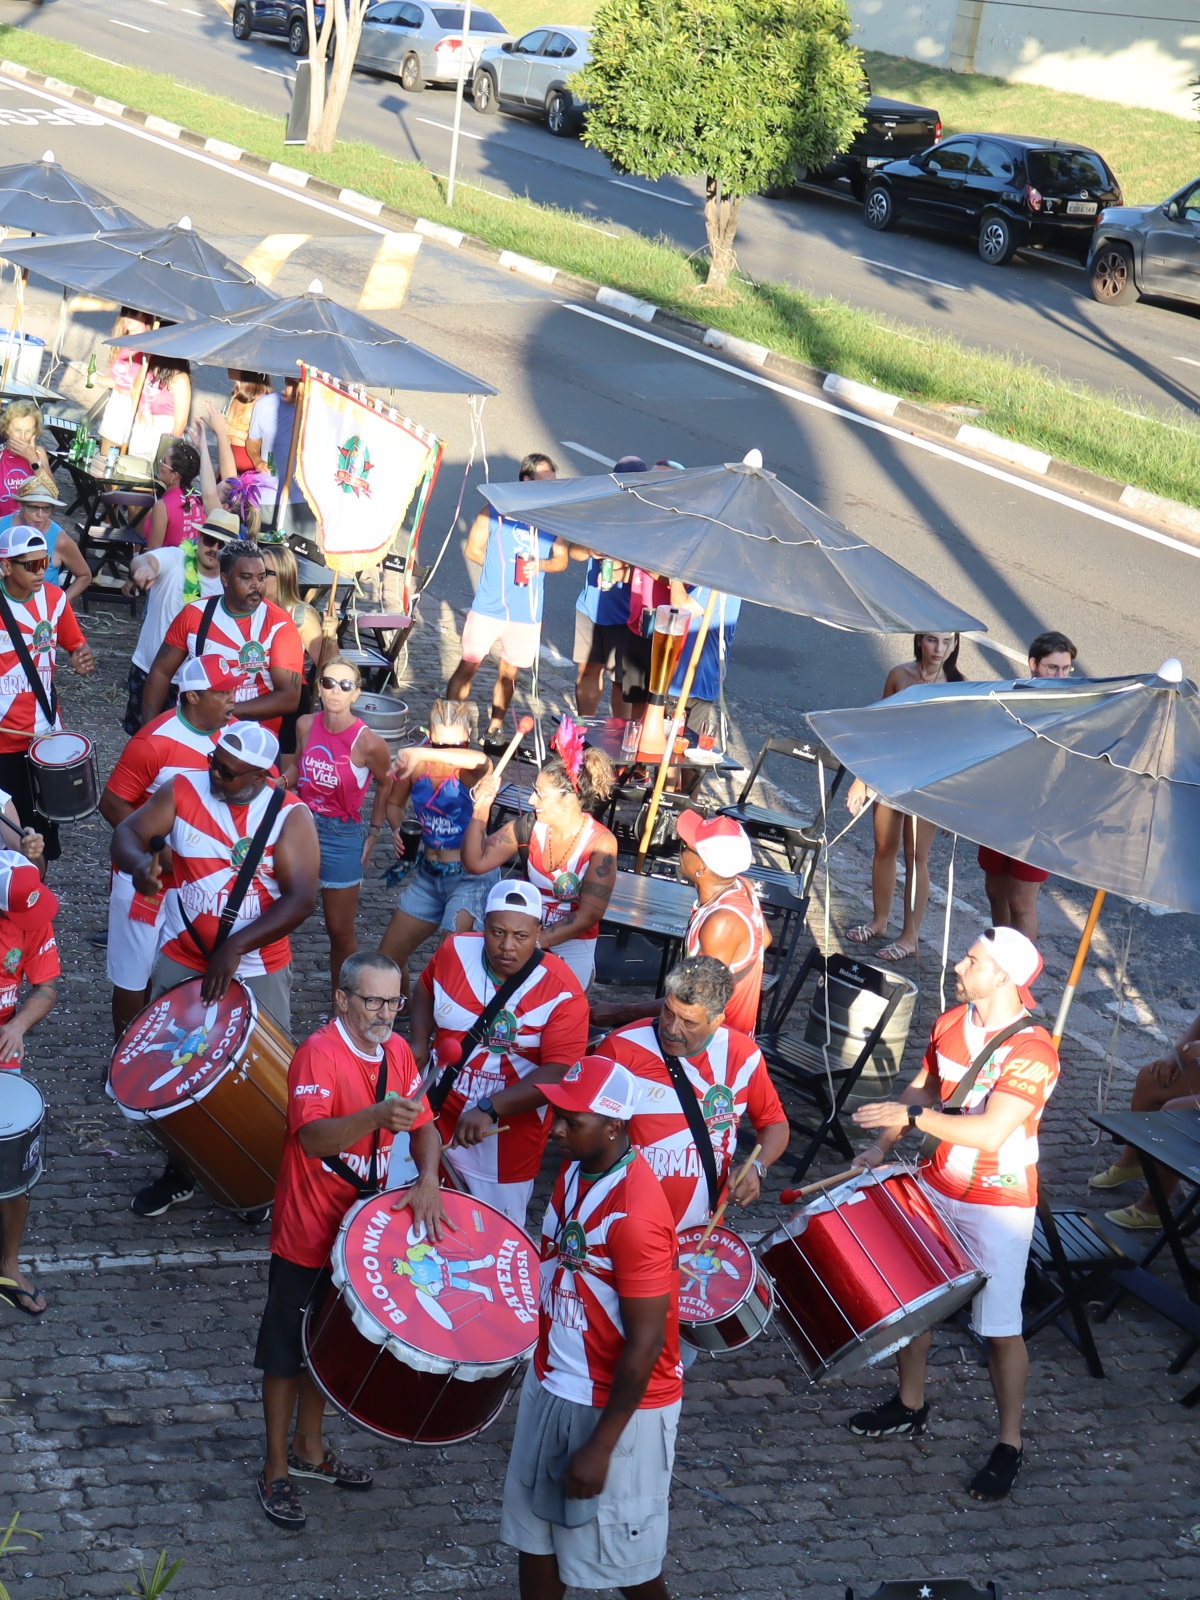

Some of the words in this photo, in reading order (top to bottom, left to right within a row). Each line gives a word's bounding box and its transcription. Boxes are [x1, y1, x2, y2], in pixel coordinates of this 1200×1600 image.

[305, 755, 335, 772] Unidos
[313, 769, 339, 787] Vida
[839, 967, 866, 983] Heineken
[118, 1000, 171, 1065] BATERIA
[120, 1005, 161, 1056] FURIOSA
[211, 1006, 243, 1060] BLOCO
[175, 1061, 214, 1096] NKM
[645, 1086, 666, 1099] 10
[362, 1209, 392, 1253] NKM
[720, 1237, 746, 1258] NKM
[362, 1255, 408, 1325] BLOCO
[496, 1238, 535, 1324] BATERIA
[516, 1249, 539, 1316] FURIOSA
